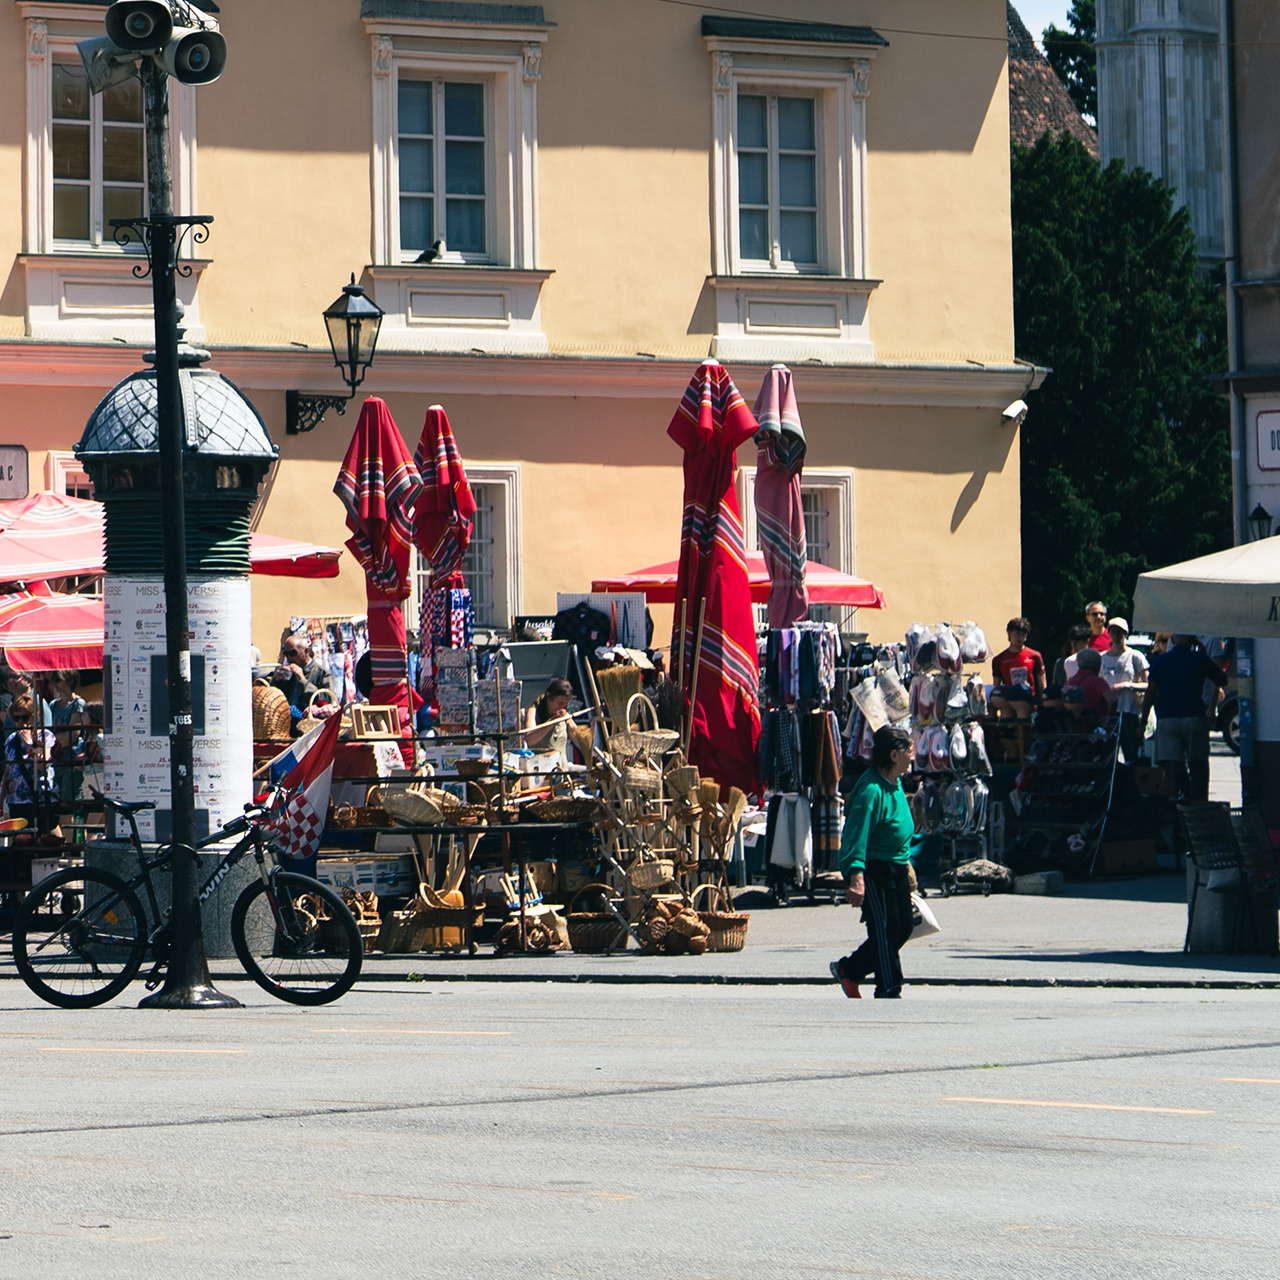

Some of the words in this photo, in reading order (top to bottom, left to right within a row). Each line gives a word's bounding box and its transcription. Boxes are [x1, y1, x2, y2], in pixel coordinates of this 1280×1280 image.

[135, 586, 160, 596] MISS
[187, 586, 220, 596] VERSE
[138, 739, 163, 750] MISS
